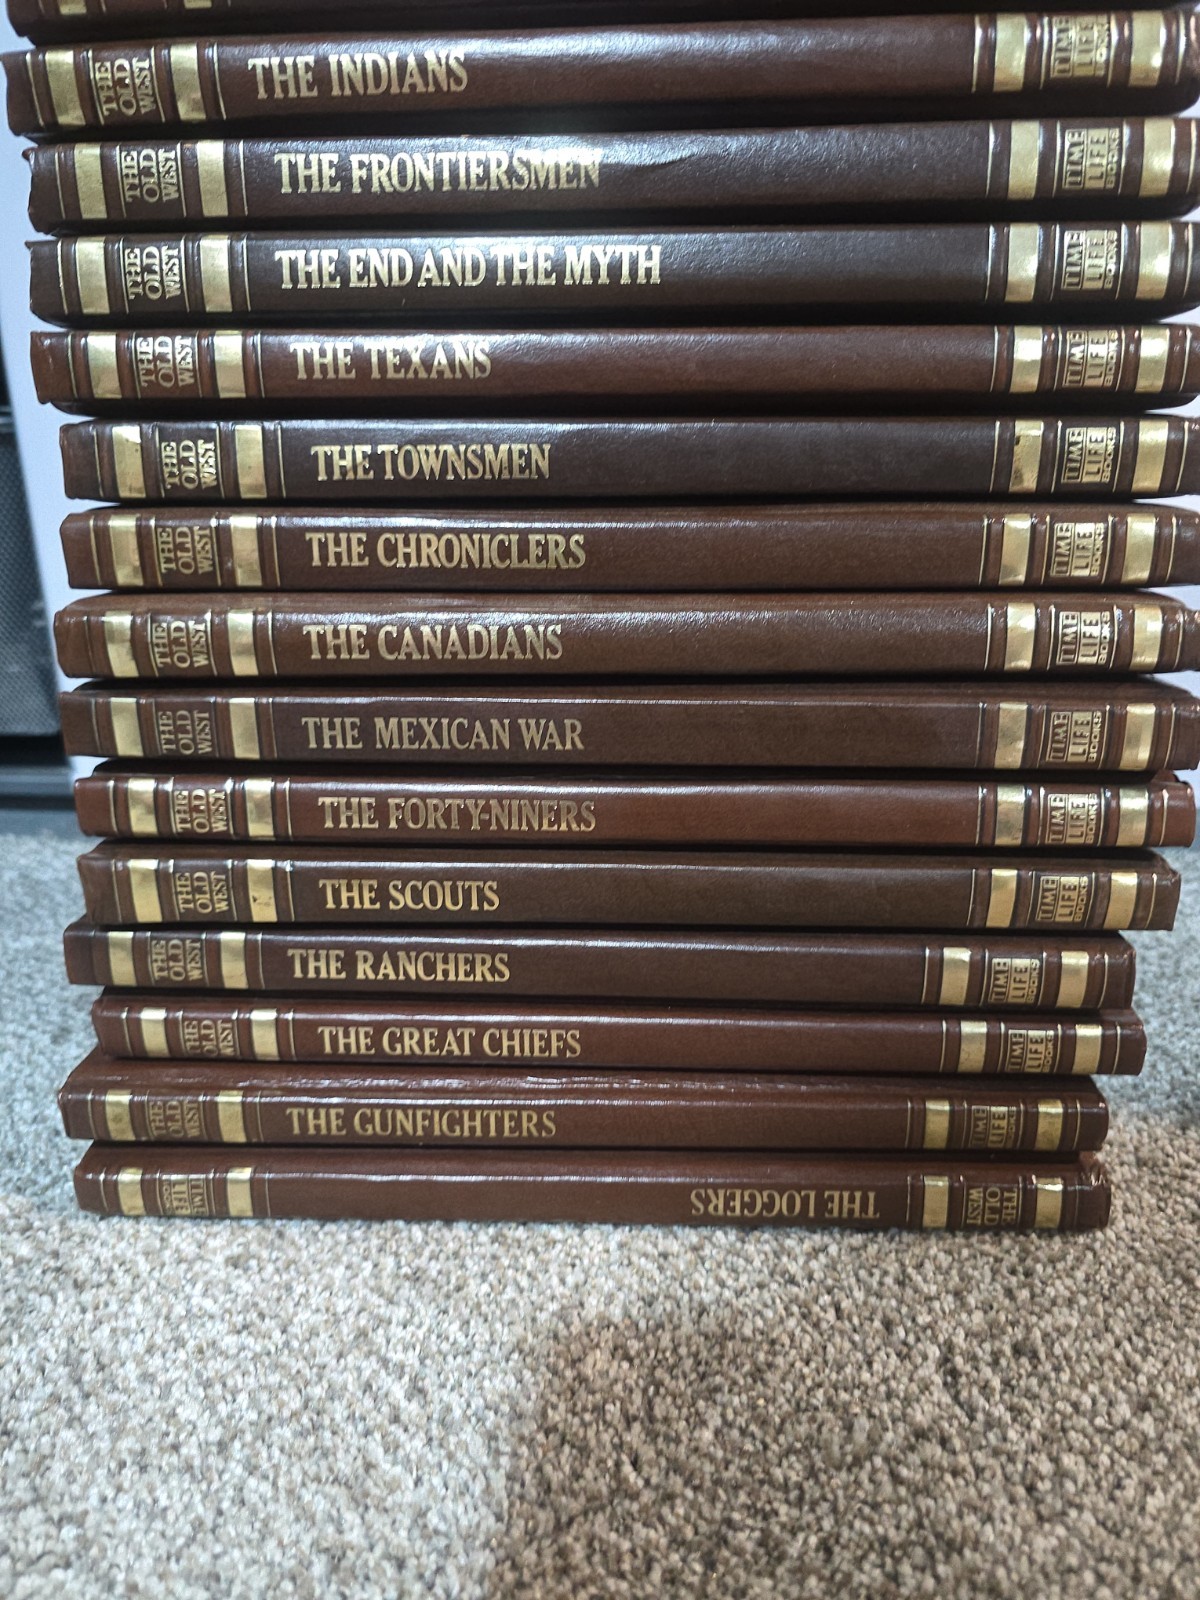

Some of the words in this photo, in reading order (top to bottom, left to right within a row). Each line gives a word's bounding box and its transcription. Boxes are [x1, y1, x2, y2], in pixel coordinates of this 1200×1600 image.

[1053, 17, 1071, 75] TIME
[1074, 19, 1095, 68] LIFE
[96, 61, 117, 116] THE
[114, 58, 137, 116] OLD
[132, 57, 156, 114] WEST
[248, 55, 318, 99] THE
[328, 50, 469, 97] INDIANS
[121, 150, 140, 202] THE
[140, 149, 160, 203] OLD
[159, 149, 180, 201] WEST
[274, 152, 341, 194] THE
[350, 148, 601, 194] FRONTIERSMEN
[1066, 130, 1085, 188] TIME
[1088, 135, 1106, 181] LIFE
[126, 248, 144, 300] THE
[143, 246, 163, 300] OLD
[162, 246, 181, 300] WEST
[274, 249, 341, 289] THE
[348, 247, 414, 288] END
[416, 246, 487, 287] AND
[489, 246, 557, 287] THE
[563, 244, 662, 286] MYTH
[1065, 231, 1082, 289] TIME
[1086, 236, 1104, 282] LIFE
[137, 336, 156, 387] THE
[154, 336, 175, 387] OLD
[175, 335, 195, 386] WEST
[290, 342, 356, 380] THE
[363, 340, 492, 380] TEXANS
[1067, 332, 1086, 385] TIME
[1087, 336, 1105, 380] LIFE
[162, 441, 181, 490] THE
[179, 440, 198, 490] OLD
[198, 440, 218, 490] WEST
[310, 444, 375, 481] THE
[377, 443, 551, 481] TOWNSMEN
[1065, 429, 1085, 482] TIME
[1085, 433, 1104, 475] LIFE
[157, 527, 177, 574] THE
[175, 526, 195, 575] OLD
[194, 526, 214, 574] WEST
[305, 532, 369, 567] THE
[376, 532, 586, 570] CHRONICLERS
[1054, 524, 1073, 575] TIME
[1074, 531, 1093, 570] LIFE
[152, 623, 172, 668] THE
[171, 620, 191, 668] OLD
[188, 620, 209, 668] WEST
[302, 624, 371, 660] THE
[377, 623, 563, 661] CANADIANS
[1060, 613, 1079, 664] TIME
[1081, 617, 1100, 658] LIFE
[159, 711, 177, 754] THE
[177, 710, 195, 755] OLD
[194, 710, 213, 754] WEST
[301, 717, 363, 749] THE
[373, 717, 511, 750] MEXICAN
[517, 718, 585, 750] WAR
[1049, 713, 1070, 761] TIME
[1071, 718, 1090, 757] LIFE
[174, 790, 191, 833] THE
[192, 789, 210, 834] OLD
[209, 788, 228, 833] WEST
[318, 797, 379, 829] THE
[387, 797, 596, 832] FORTY-NINERS
[1049, 795, 1067, 842] TIME
[1069, 802, 1086, 839] LIFE
[176, 873, 194, 913] THE
[194, 871, 213, 914] OLD
[211, 871, 230, 913] WEST
[319, 879, 380, 910] THE
[388, 880, 500, 911] SCOUTS
[1039, 877, 1058, 920] TIME
[1058, 883, 1078, 918] LIFE
[152, 940, 168, 980] THE
[168, 939, 185, 981] OLD
[186, 939, 203, 981] WEST
[287, 949, 346, 980] THE
[355, 950, 510, 982] RANCHERS
[991, 960, 1009, 1002] TIME
[1012, 965, 1028, 998] LIFE
[318, 1026, 375, 1055] THE
[382, 1026, 476, 1056] GREAT
[482, 1028, 582, 1058] CHIEFS
[1008, 1031, 1026, 1071] TIME
[1027, 1036, 1044, 1068] LIFE
[286, 1107, 346, 1136] THE
[354, 1107, 556, 1138] GUNFIGHTERS
[990, 1111, 1006, 1144] LIFE
[172, 1179, 190, 1214] LIFE
[690, 1188, 816, 1218] LOGGERS
[825, 1190, 880, 1219] THE
[967, 1187, 983, 1226] WEST
[984, 1187, 1000, 1225] OLD
[1003, 1188, 1018, 1225] THE
